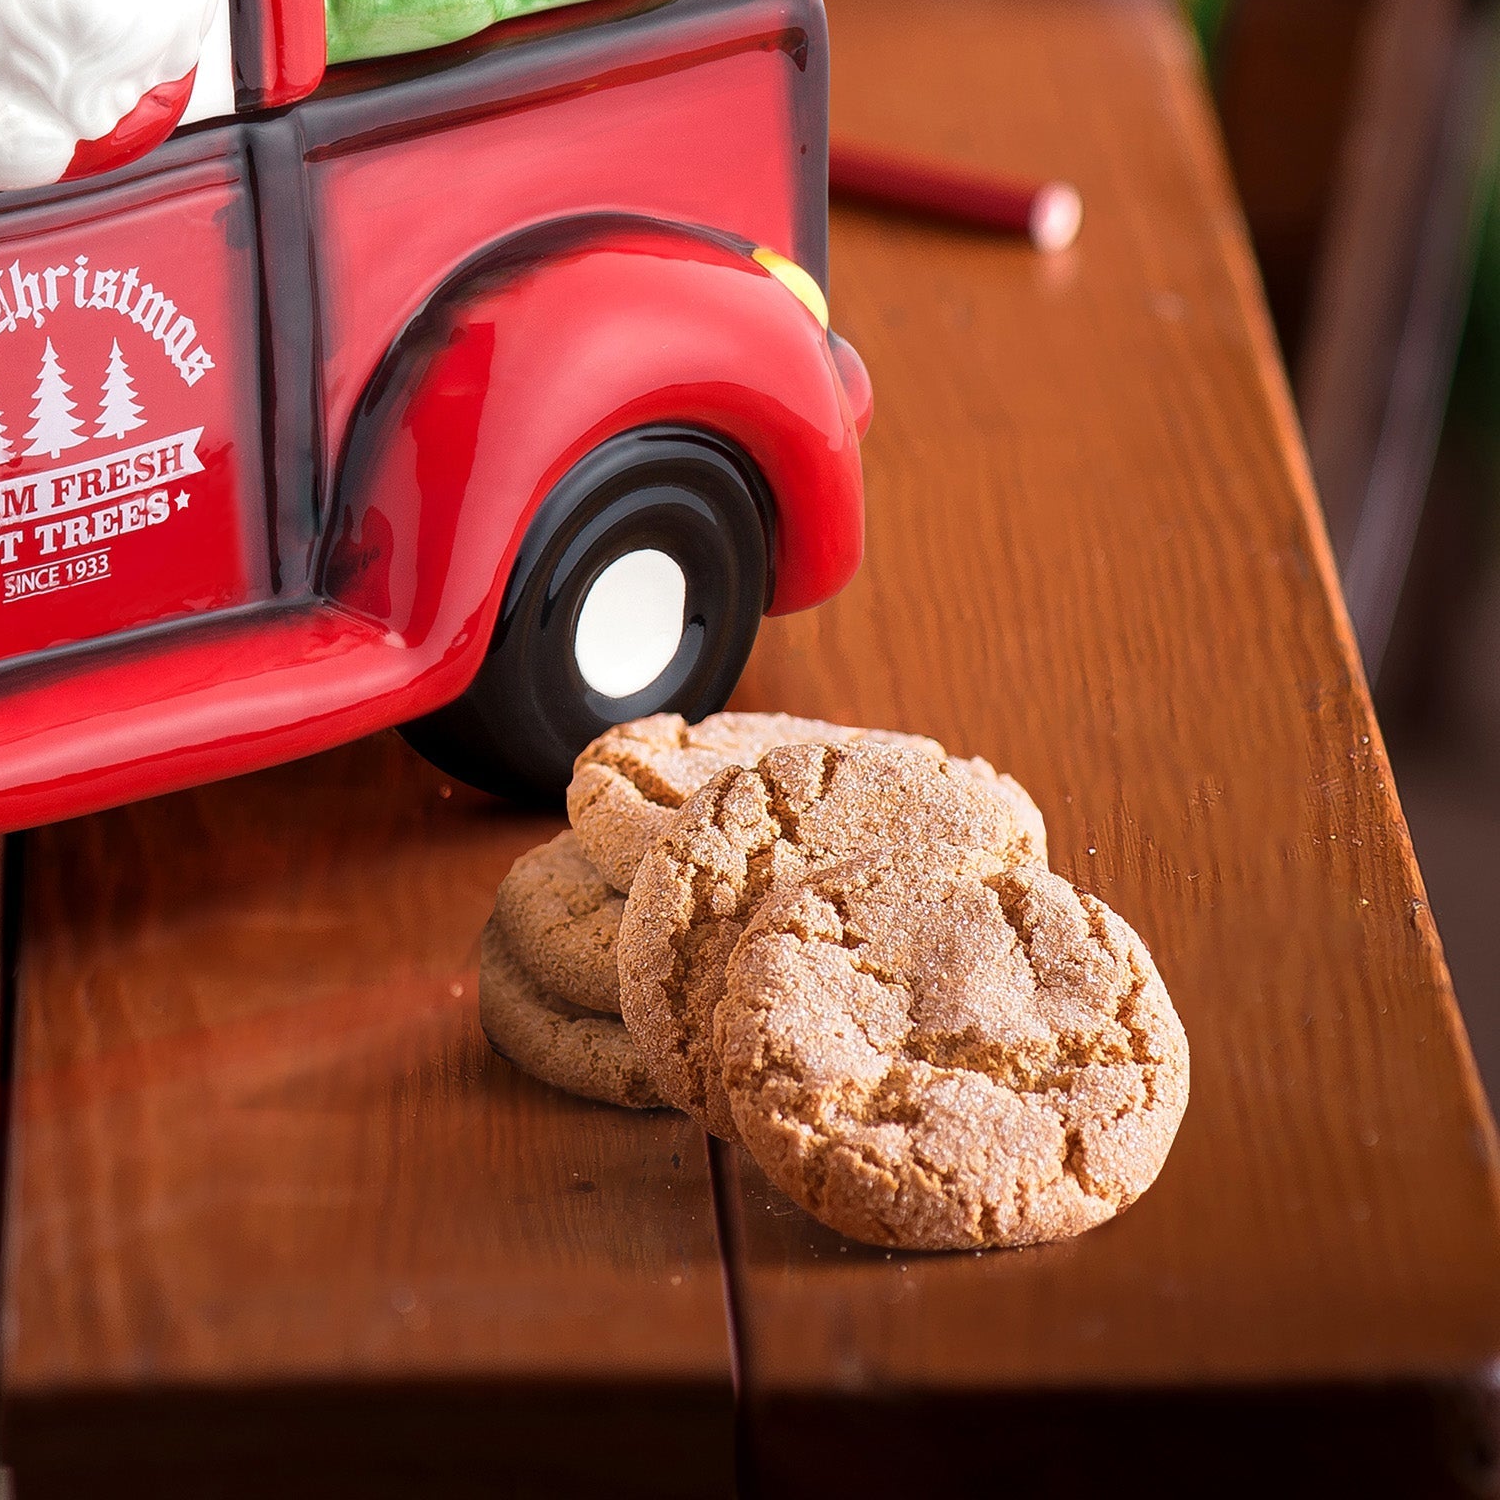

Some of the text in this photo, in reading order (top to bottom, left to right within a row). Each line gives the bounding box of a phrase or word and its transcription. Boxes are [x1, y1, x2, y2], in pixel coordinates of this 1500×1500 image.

[51, 443, 185, 507] FRESH
[34, 489, 170, 556] TREES
[3, 554, 109, 597] SINCE 1933
